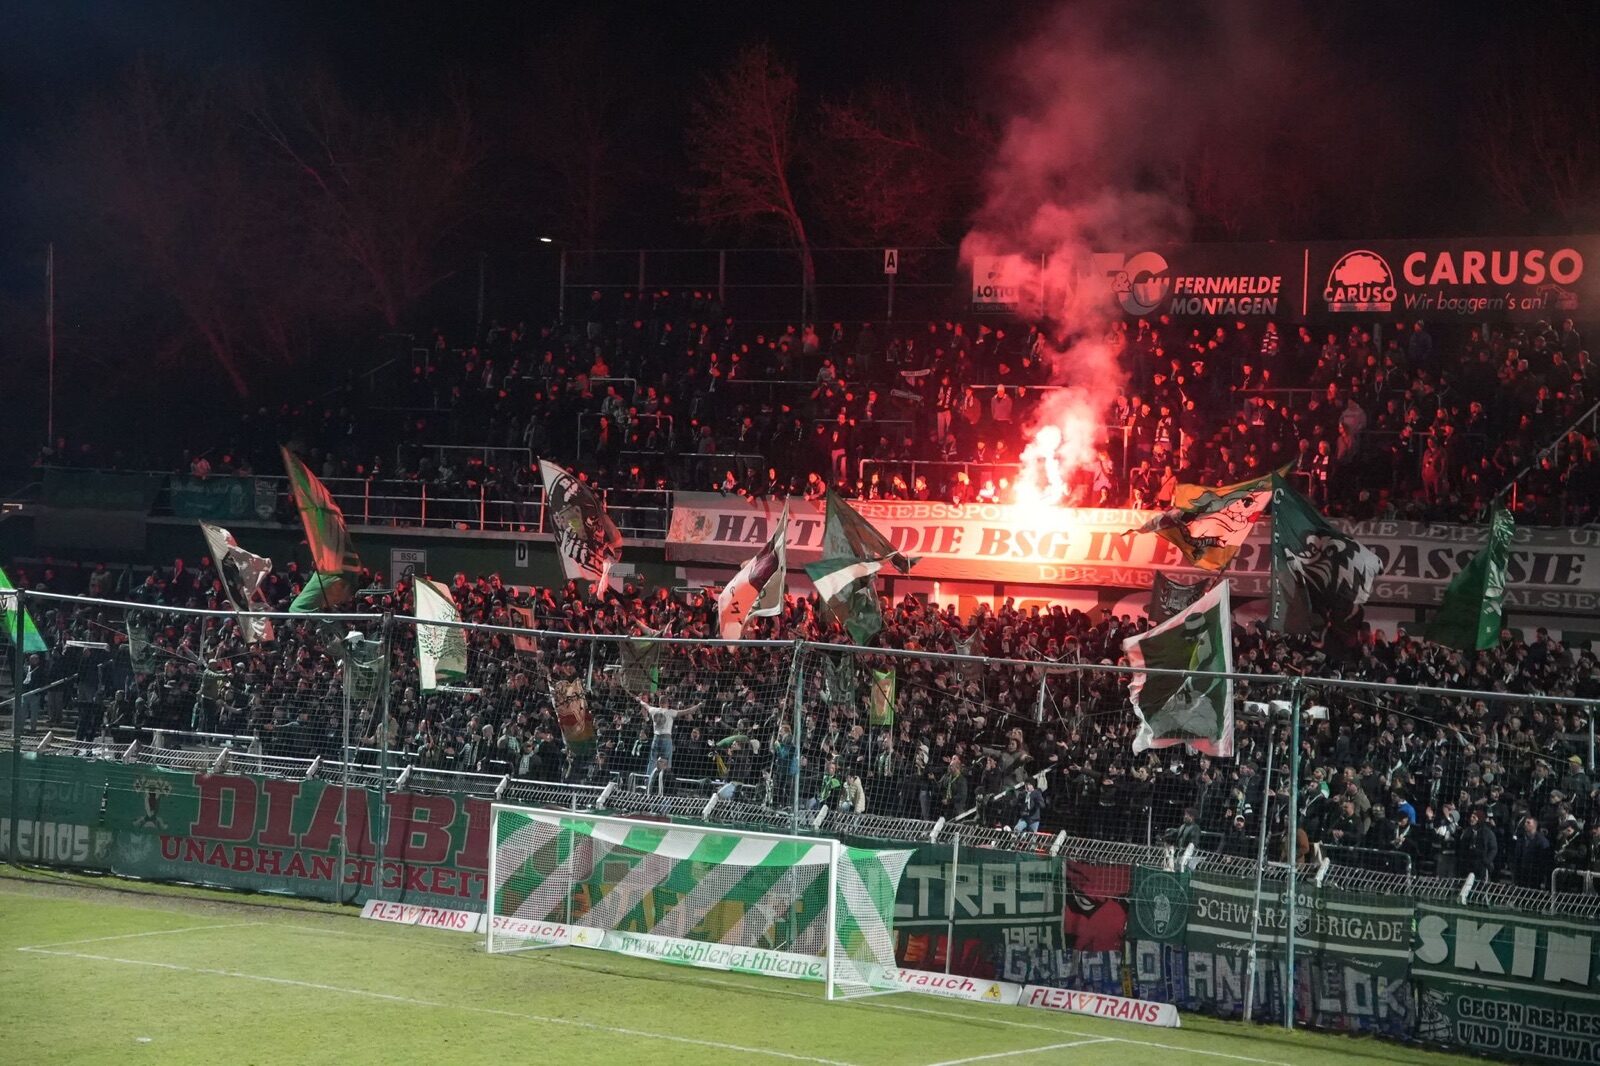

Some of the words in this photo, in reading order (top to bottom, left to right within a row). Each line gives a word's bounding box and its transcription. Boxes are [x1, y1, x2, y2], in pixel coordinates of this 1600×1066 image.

[886, 251, 896, 268] A
[1402, 248, 1584, 288] CARUSO
[1173, 276, 1281, 294] FERNMELDE
[1323, 285, 1397, 302] CARUSO
[1170, 298, 1278, 316] MONTAGEN
[1403, 293, 1434, 310] Wir
[1408, 521, 1533, 543] LEIPZG
[518, 543, 526, 560] D
[889, 526, 964, 555] DIE
[976, 527, 1071, 559] BSG
[1084, 531, 1137, 562] IN
[1002, 926, 1053, 951] 1964
[1315, 914, 1403, 942] BRIGADE
[1457, 996, 1522, 1025] GEGEN
[1457, 1021, 1502, 1048] UND
